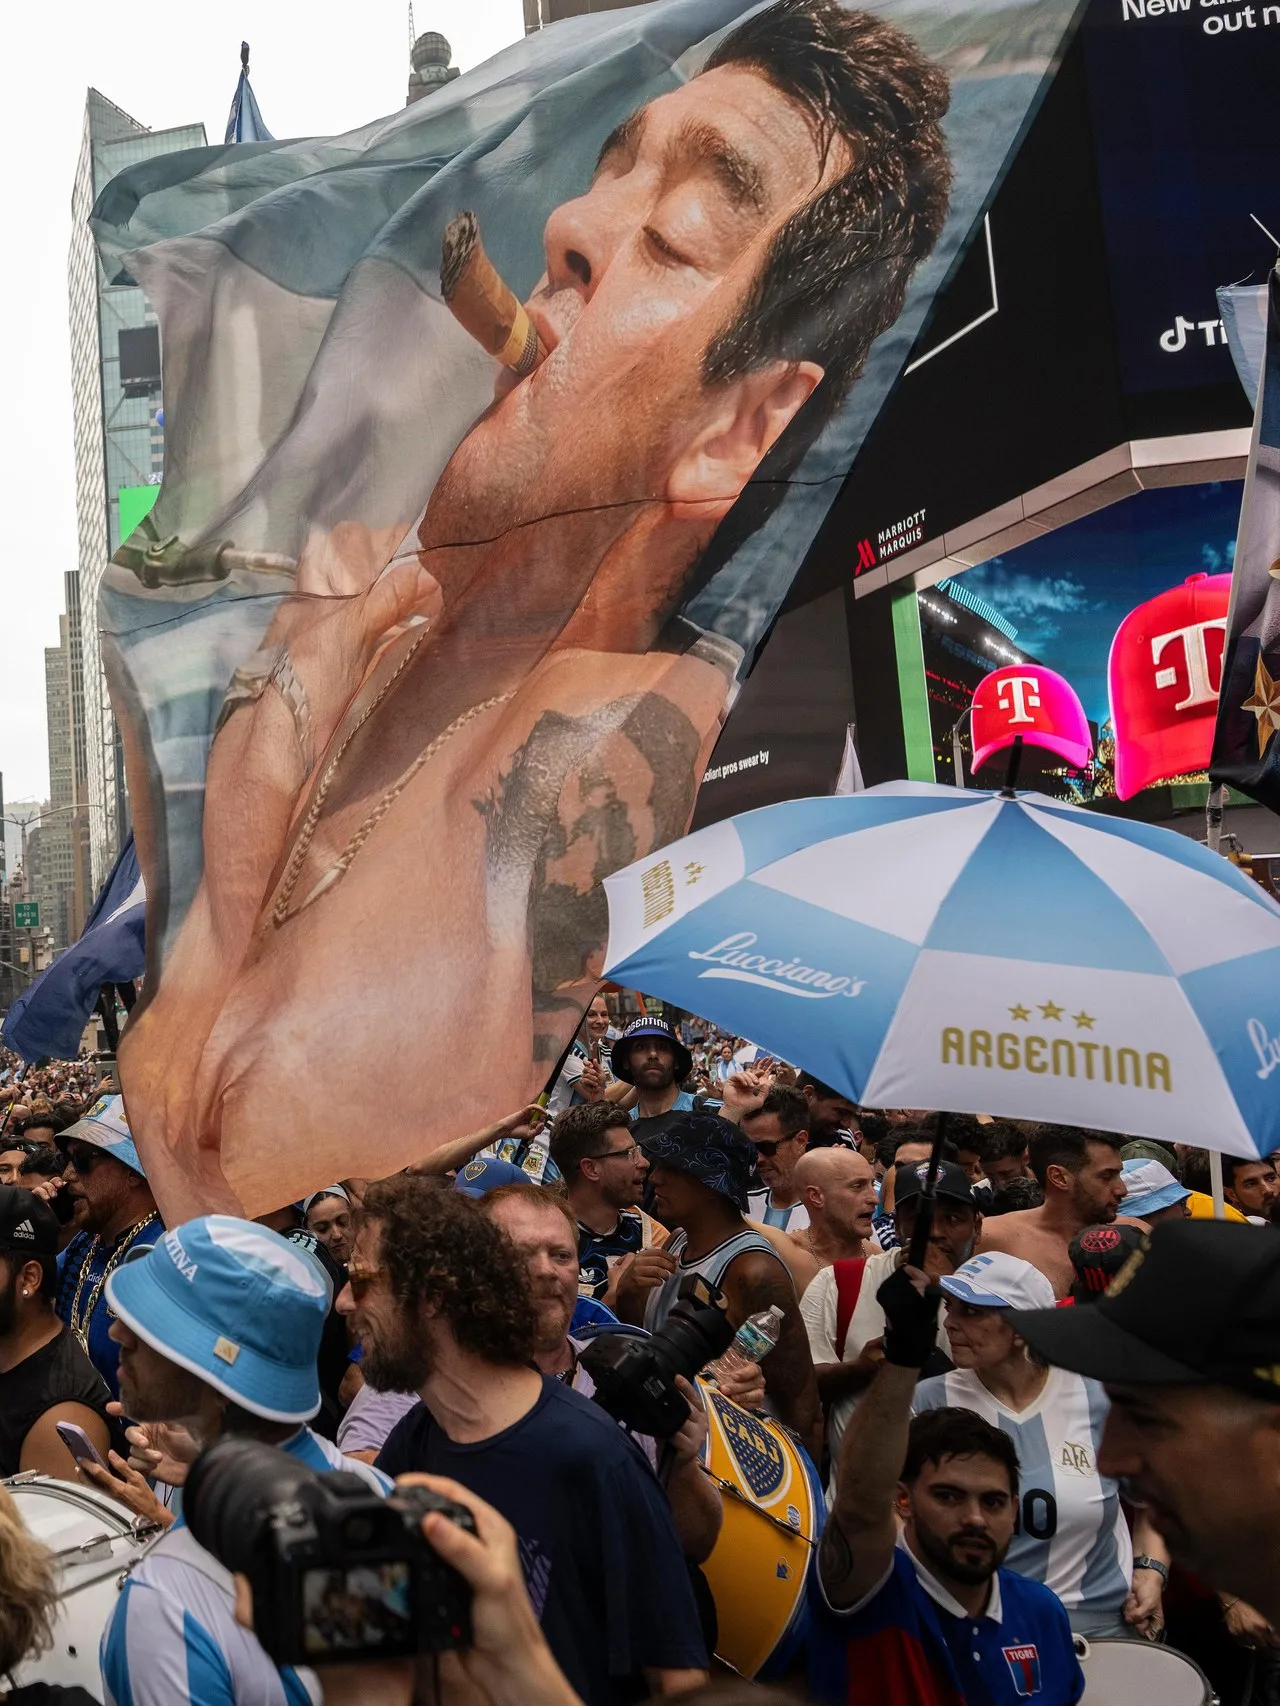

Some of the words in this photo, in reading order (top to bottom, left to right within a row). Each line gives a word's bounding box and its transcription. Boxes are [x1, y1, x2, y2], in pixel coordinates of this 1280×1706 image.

[1122, 0, 1191, 21] New
[1203, 5, 1256, 35] out
[877, 508, 927, 545] MARRIOTT
[878, 528, 923, 559] MARQUIS
[722, 761, 737, 779] pros
[739, 755, 759, 770] swear
[760, 750, 769, 764] by
[640, 857, 676, 928] ARGENTINA
[687, 931, 868, 999] Lucciano's
[940, 1025, 1173, 1094] ARGENTINA
[13, 1230, 35, 1240] adidas
[722, 1413, 780, 1465] CABJ
[1061, 1441, 1090, 1475] AFA
[1008, 1648, 1035, 1661] TIGRE
